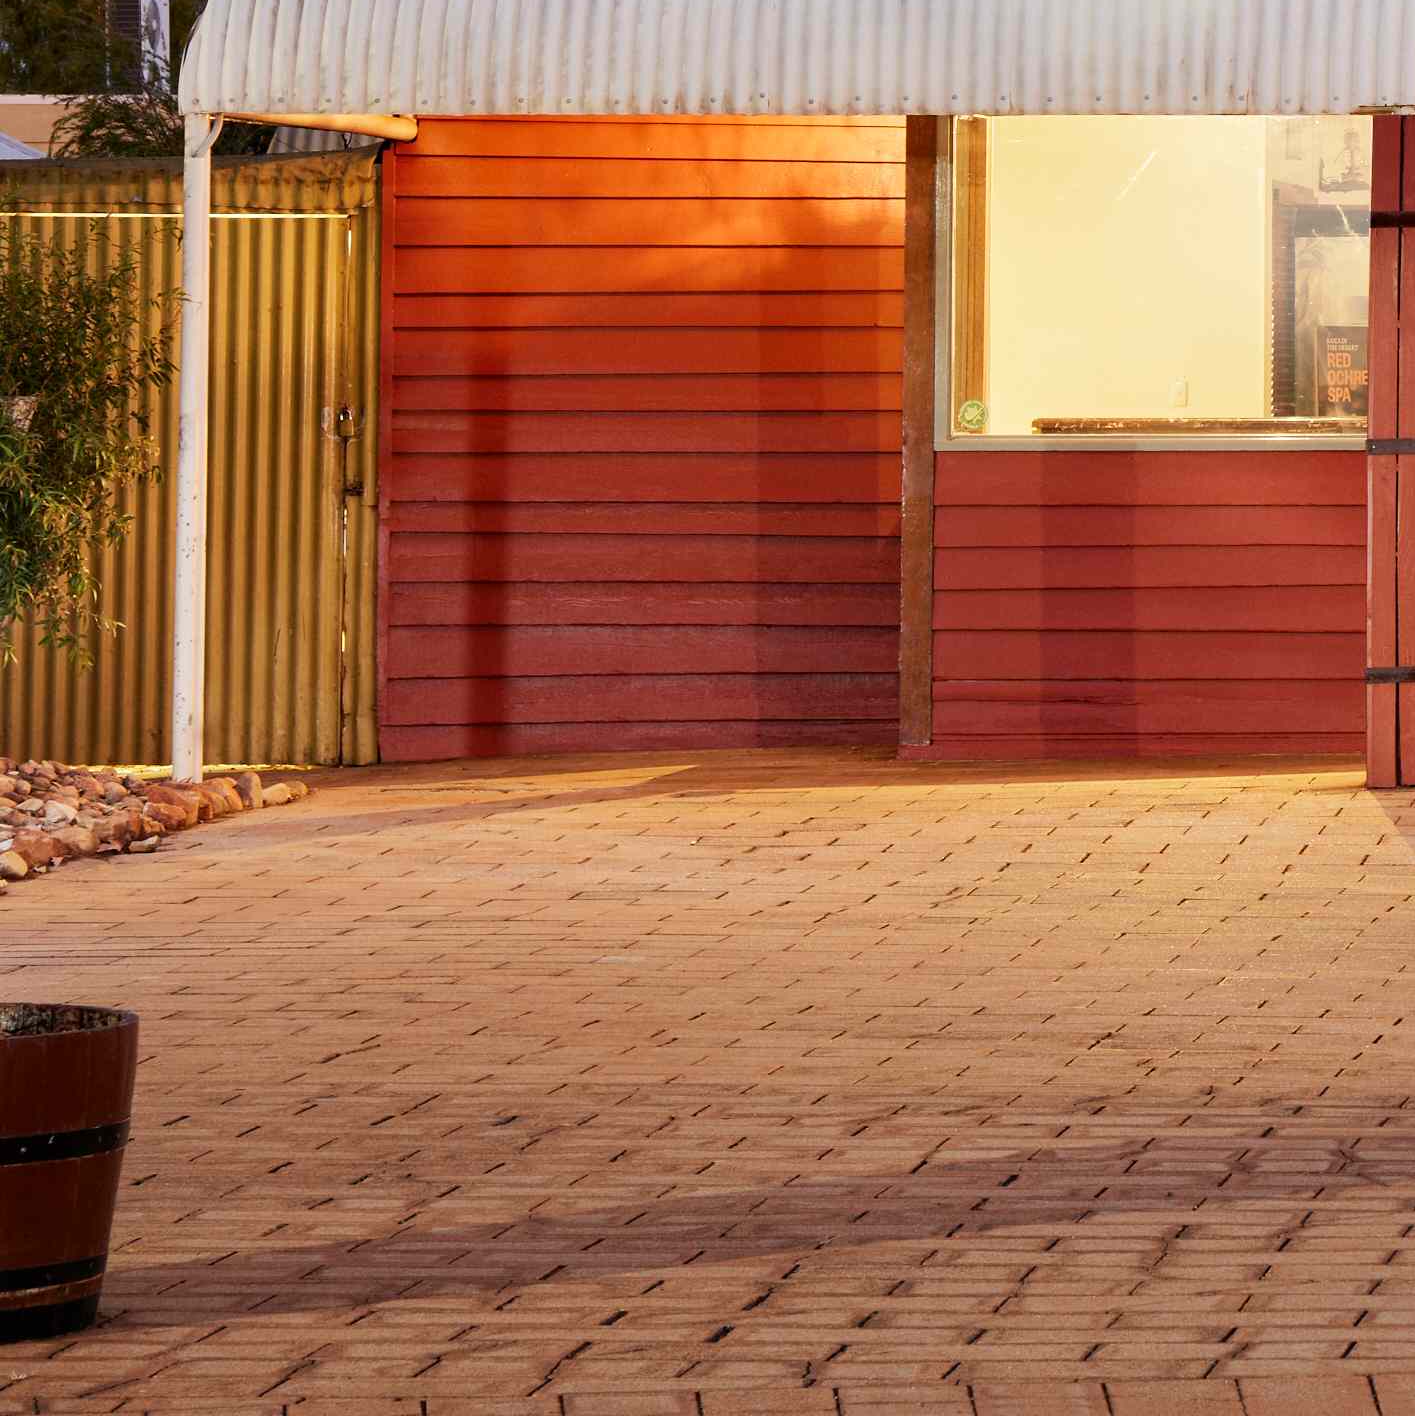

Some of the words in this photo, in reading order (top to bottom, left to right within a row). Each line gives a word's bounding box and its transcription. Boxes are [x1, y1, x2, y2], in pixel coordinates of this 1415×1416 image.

[1327, 352, 1352, 369] RED
[1327, 369, 1369, 386] OCHRE
[1327, 386, 1352, 403] SPA
